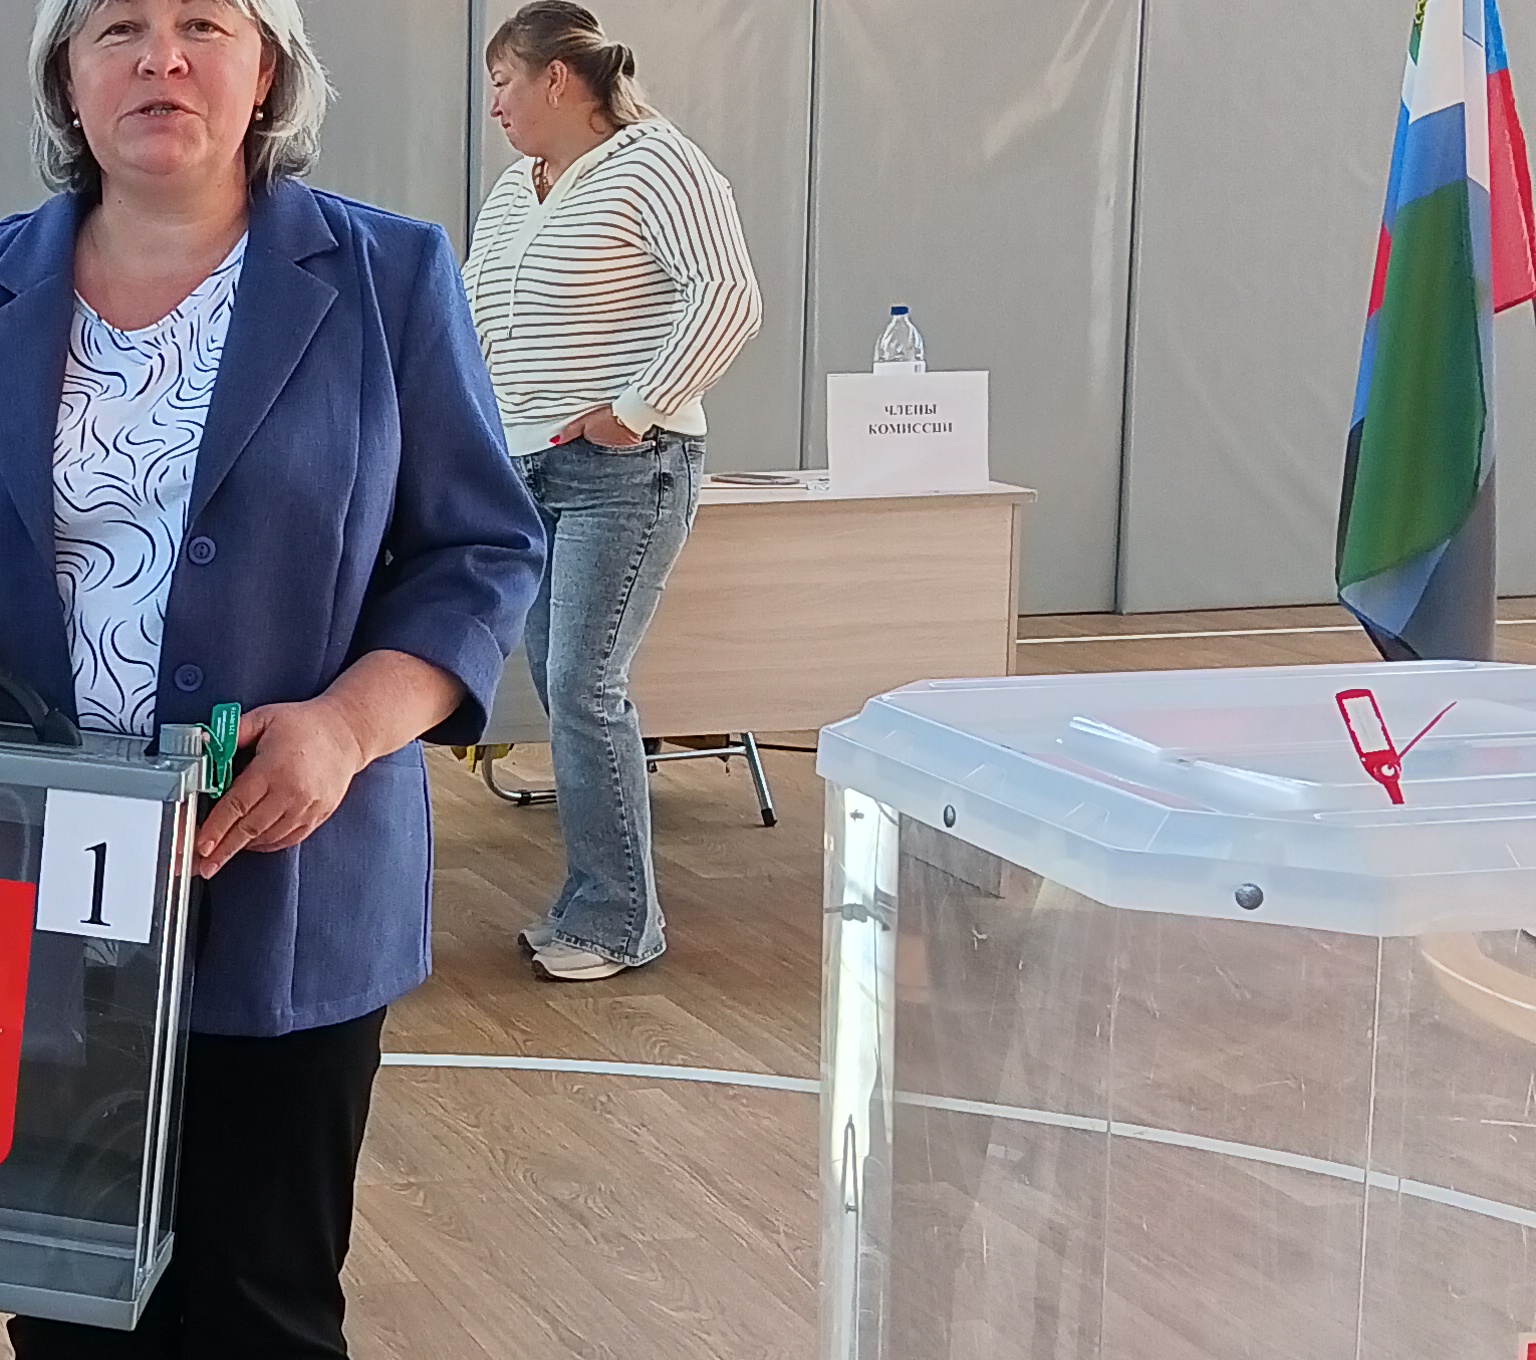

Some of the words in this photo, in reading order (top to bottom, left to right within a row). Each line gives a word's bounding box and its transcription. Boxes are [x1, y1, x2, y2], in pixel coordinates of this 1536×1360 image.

[884, 404, 938, 416] ЧЛЕНЫ
[868, 422, 953, 435] КОМИССИИ
[80, 841, 111, 927] 1
